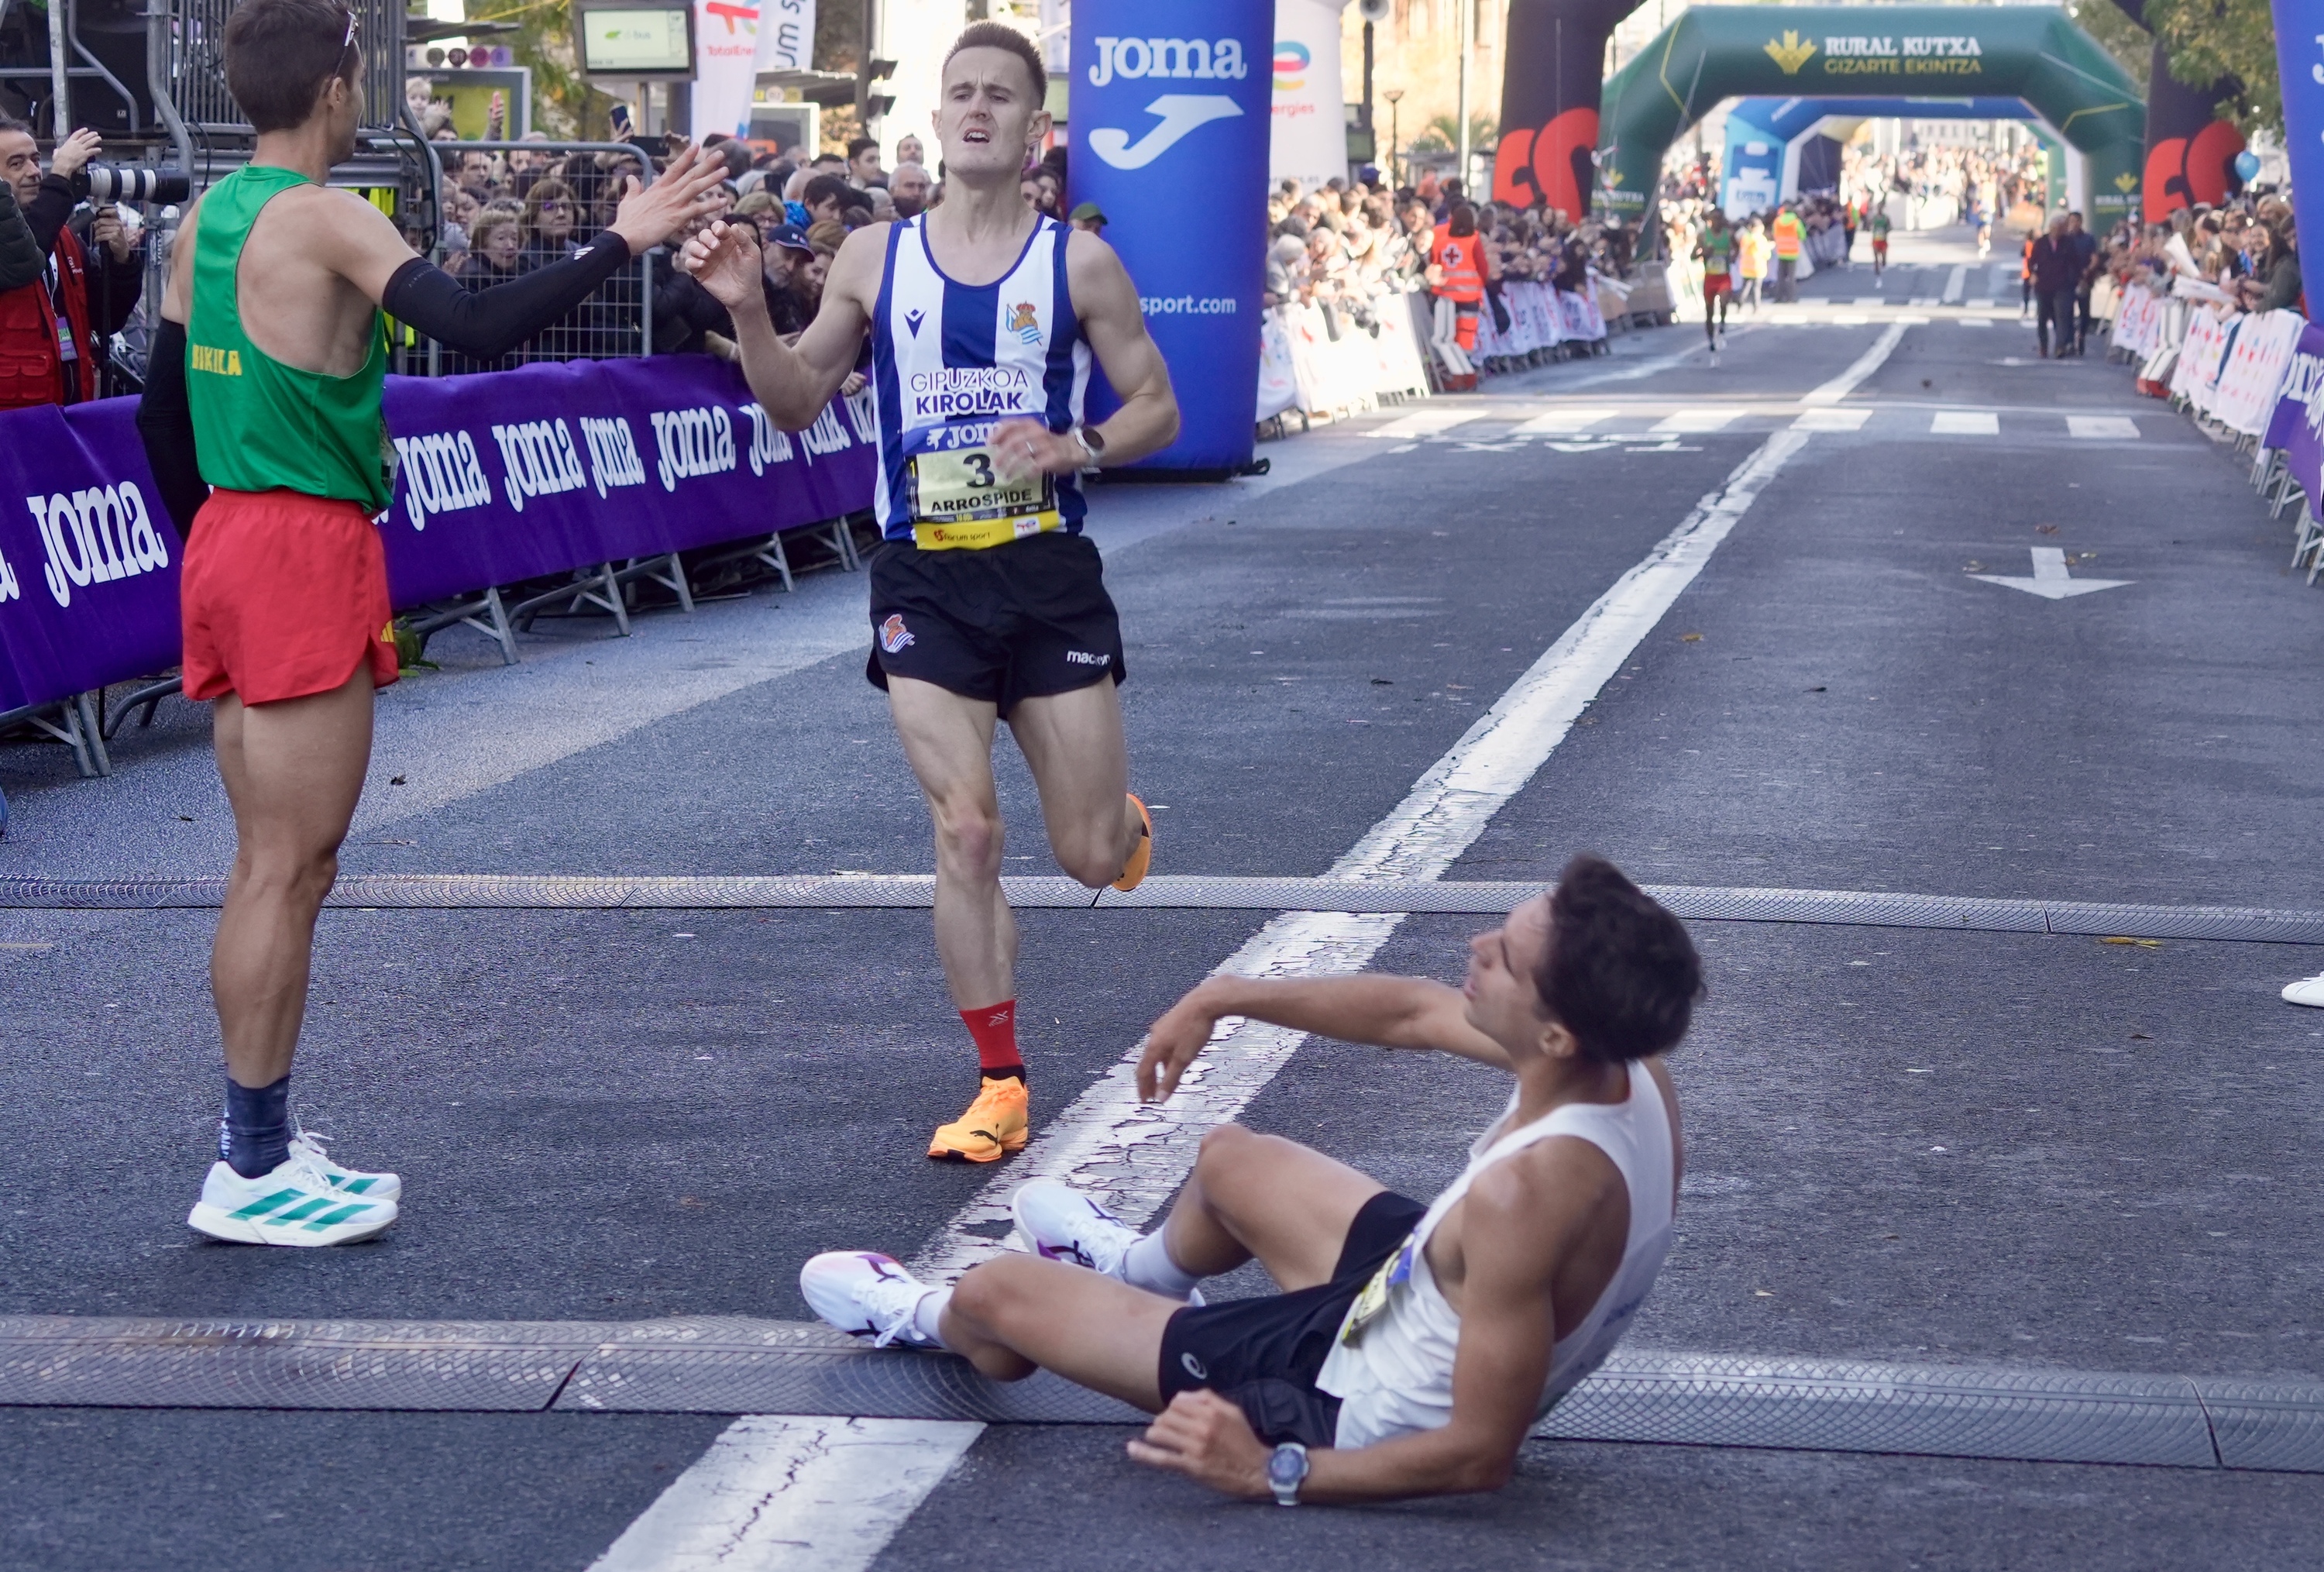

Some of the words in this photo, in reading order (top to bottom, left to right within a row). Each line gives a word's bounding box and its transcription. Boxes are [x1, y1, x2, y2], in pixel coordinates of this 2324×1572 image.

[1824, 36, 1897, 57] RURAL
[1903, 36, 1982, 56] KUTXA
[1824, 58, 1899, 74] GIZARTE
[1905, 58, 1982, 74] EKINTZA
[911, 368, 1029, 392] GIPUZKOA
[916, 391, 1023, 415] KIROLAK
[963, 453, 995, 488] 3
[930, 488, 1033, 513] ARROSPIDE
